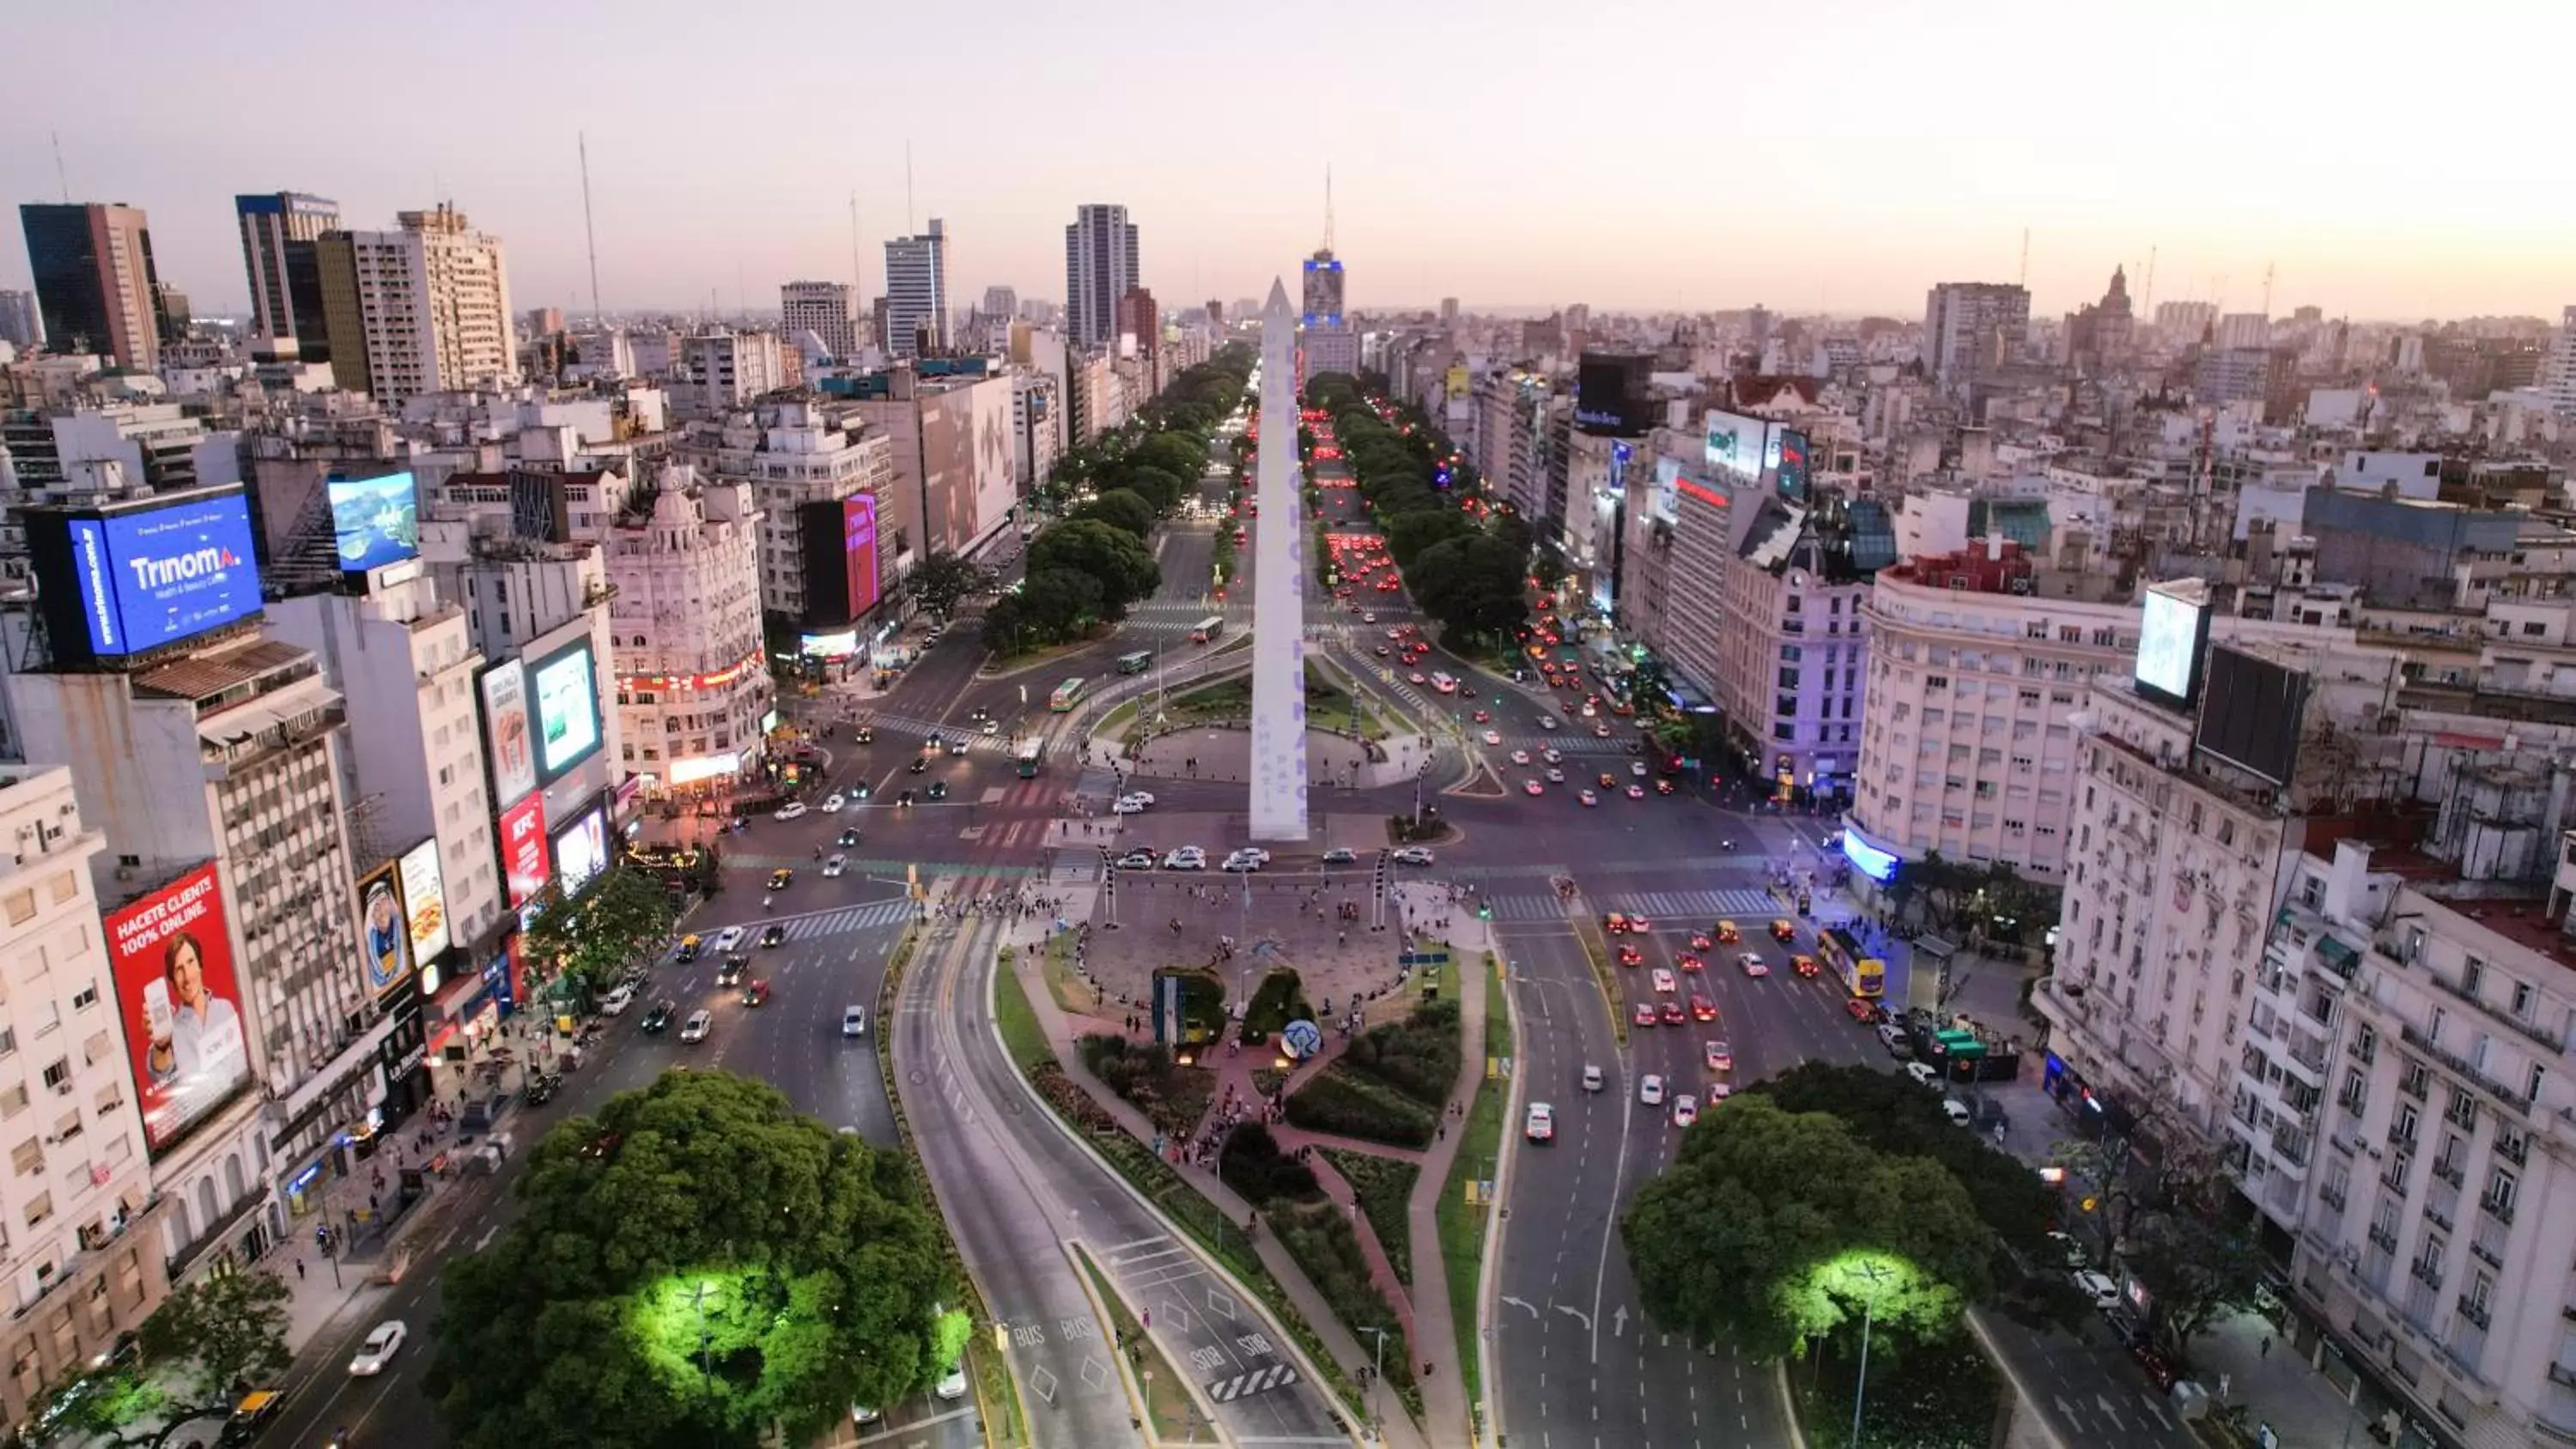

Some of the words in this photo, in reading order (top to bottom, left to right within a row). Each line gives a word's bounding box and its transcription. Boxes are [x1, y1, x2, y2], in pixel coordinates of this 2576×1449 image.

[117, 902, 167, 940] HACETE
[167, 876, 213, 912] CLIENTE
[120, 927, 159, 957] 100%
[1014, 1325, 1045, 1348] BUS
[1060, 1317, 1091, 1341] BUS
